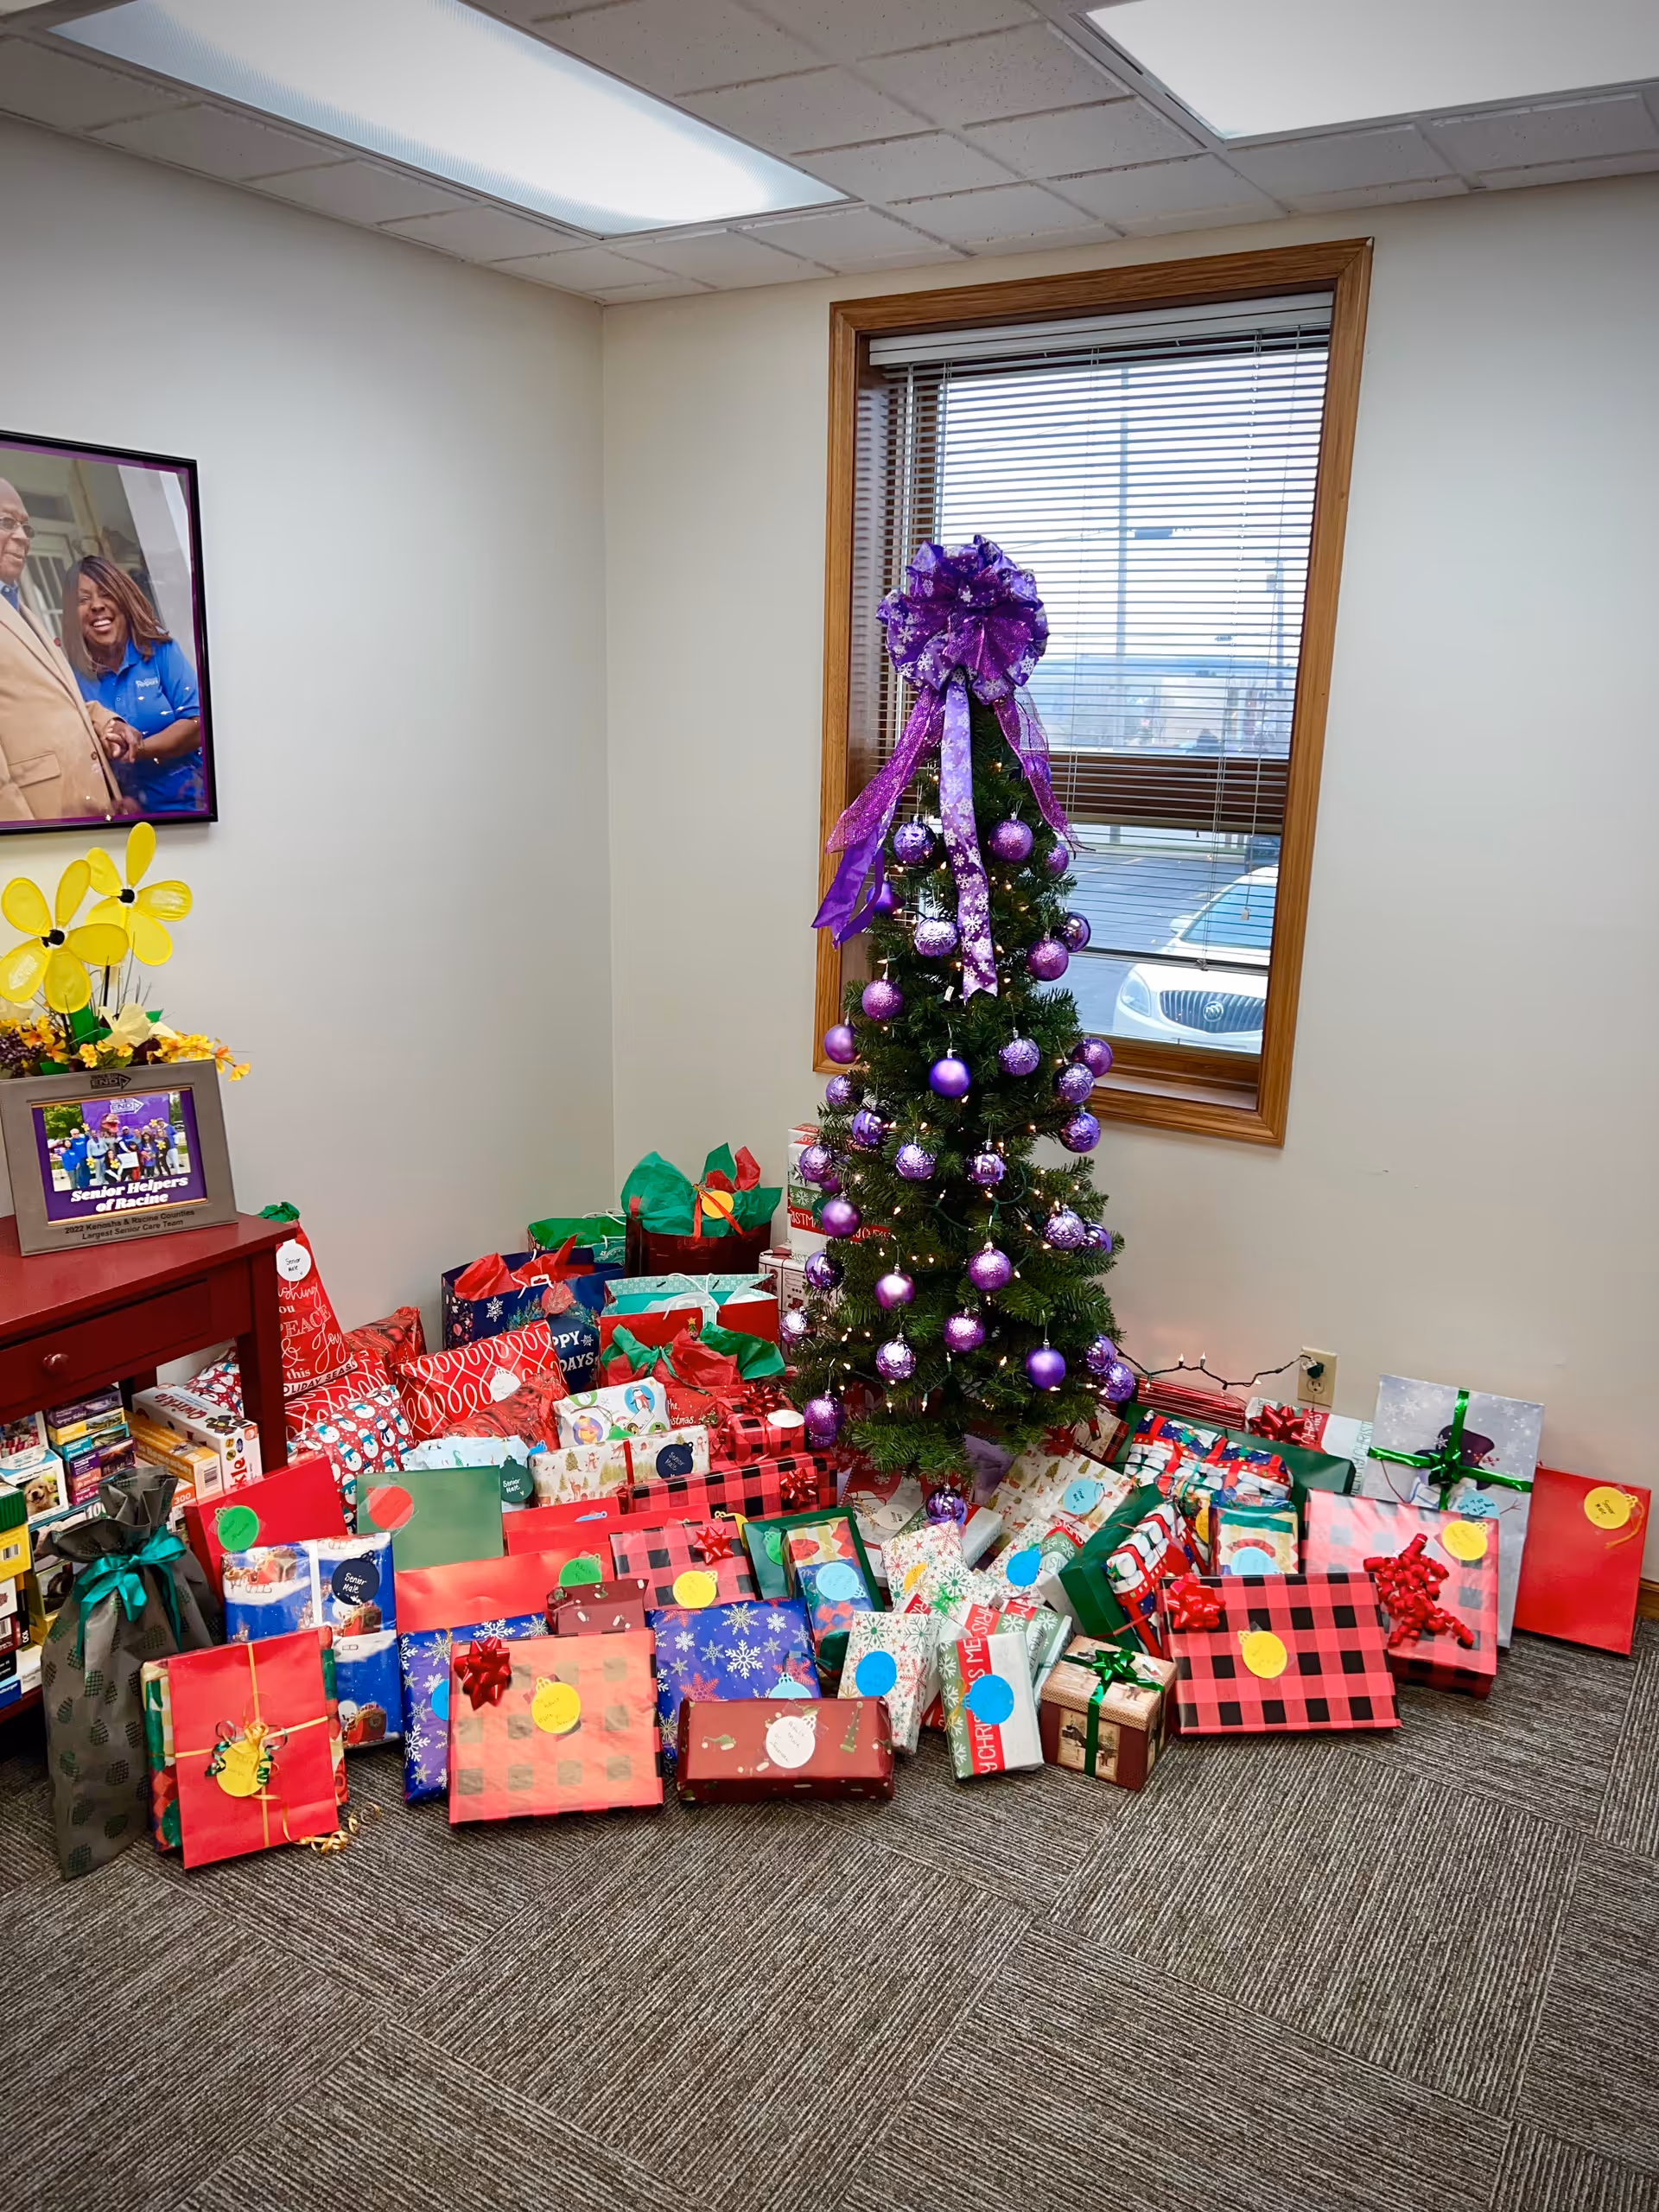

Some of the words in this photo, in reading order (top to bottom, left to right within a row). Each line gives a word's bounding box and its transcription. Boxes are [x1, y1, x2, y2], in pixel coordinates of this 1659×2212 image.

[71, 1185, 125, 1202] Senior
[127, 1177, 188, 1194] Helpers
[96, 1198, 116, 1212] of
[115, 1193, 168, 1210] Racine
[65, 1225, 84, 1234] 2022
[86, 1220, 122, 1231] Kenosha
[131, 1215, 159, 1224] Racine
[160, 1210, 195, 1220] Counties
[82, 1230, 112, 1240] Largest
[114, 1226, 141, 1236] Senior
[162, 1219, 184, 1228] Team
[278, 1304, 296, 1314] ou
[280, 1304, 332, 1338] EACE
[281, 1338, 305, 1368] &
[311, 1322, 346, 1375] Joy
[286, 1367, 311, 1381] this
[283, 1376, 323, 1395] OLIDAY
[503, 1478, 521, 1489] Senior
[505, 1484, 521, 1494] Male
[174, 1492, 192, 1505] 300
[344, 1572, 367, 1586] Senior
[342, 1582, 360, 1594] Male
